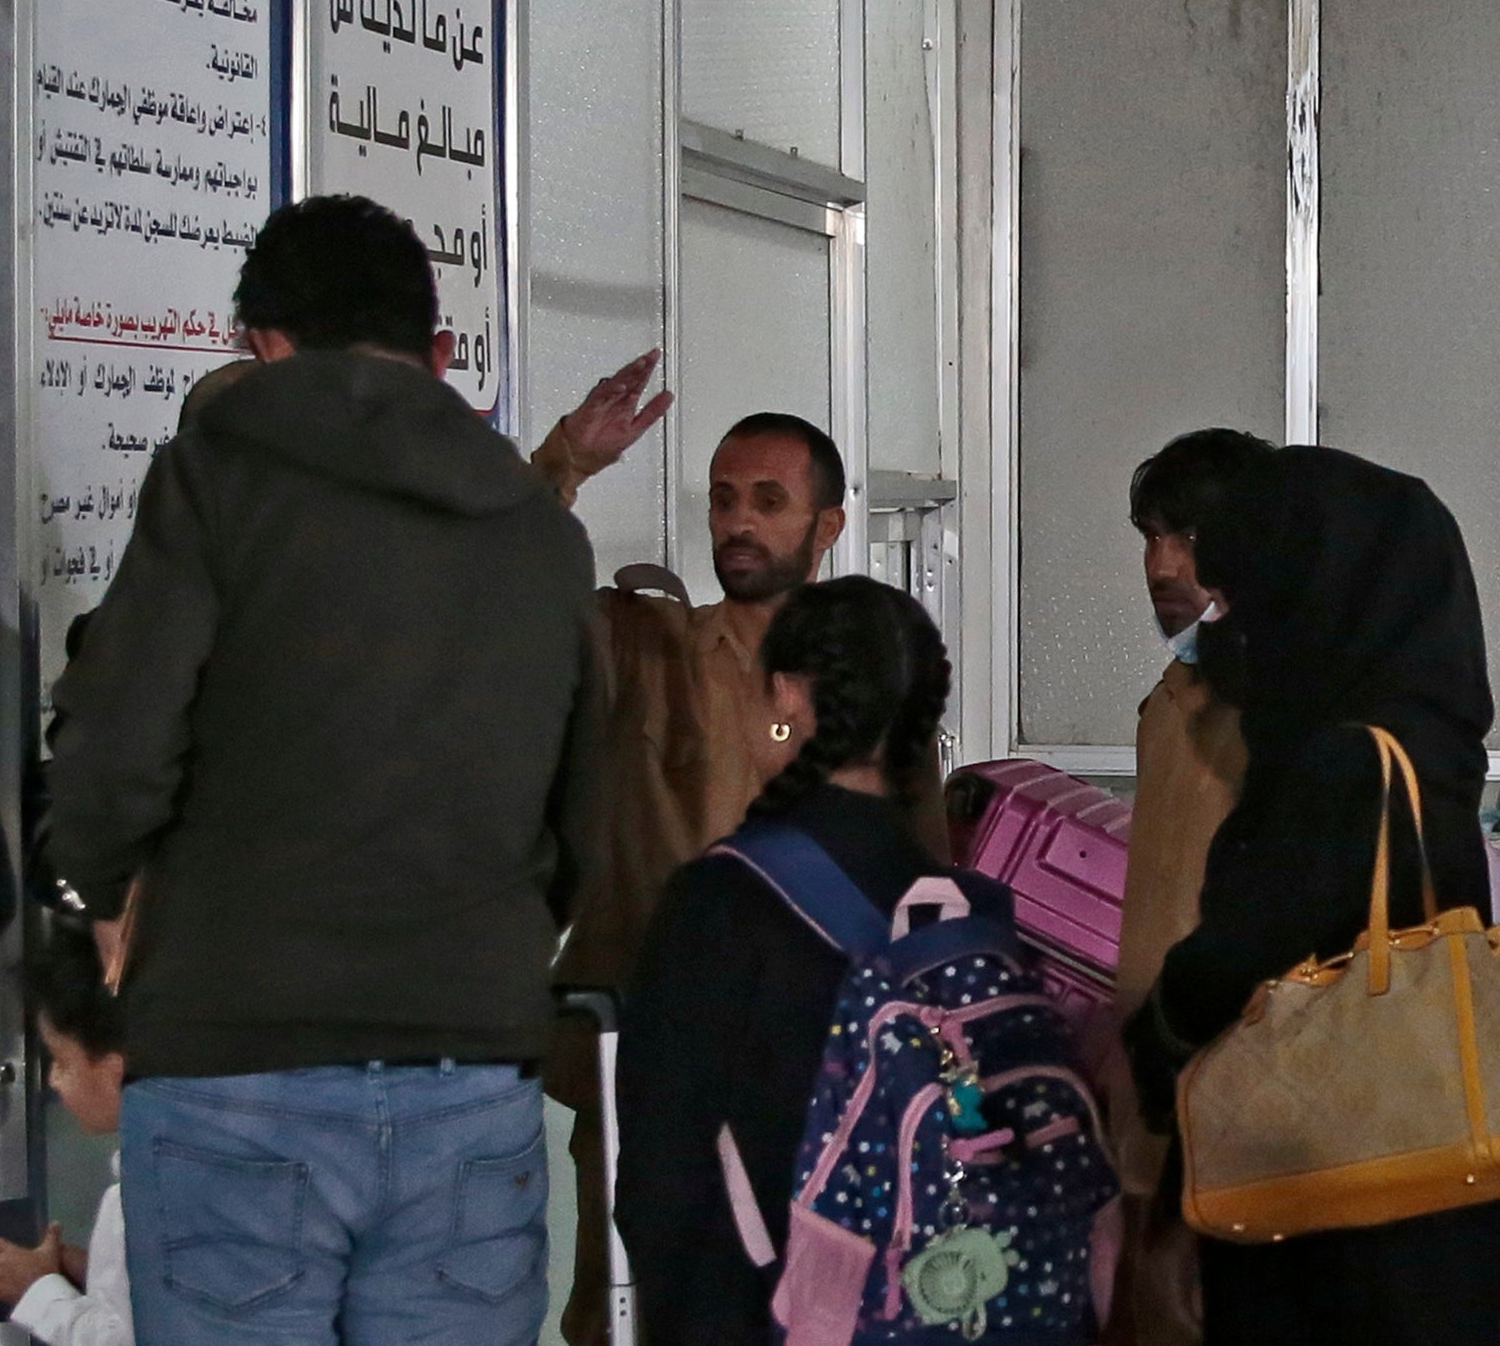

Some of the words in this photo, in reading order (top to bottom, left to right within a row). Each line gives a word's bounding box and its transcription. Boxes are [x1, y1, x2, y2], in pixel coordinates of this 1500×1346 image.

[450, 7, 484, 72] عن
[328, 73, 410, 158] مالية
[416, 98, 485, 181] مبالغ
[469, 203, 489, 289] أو
[474, 322, 492, 391] أو
